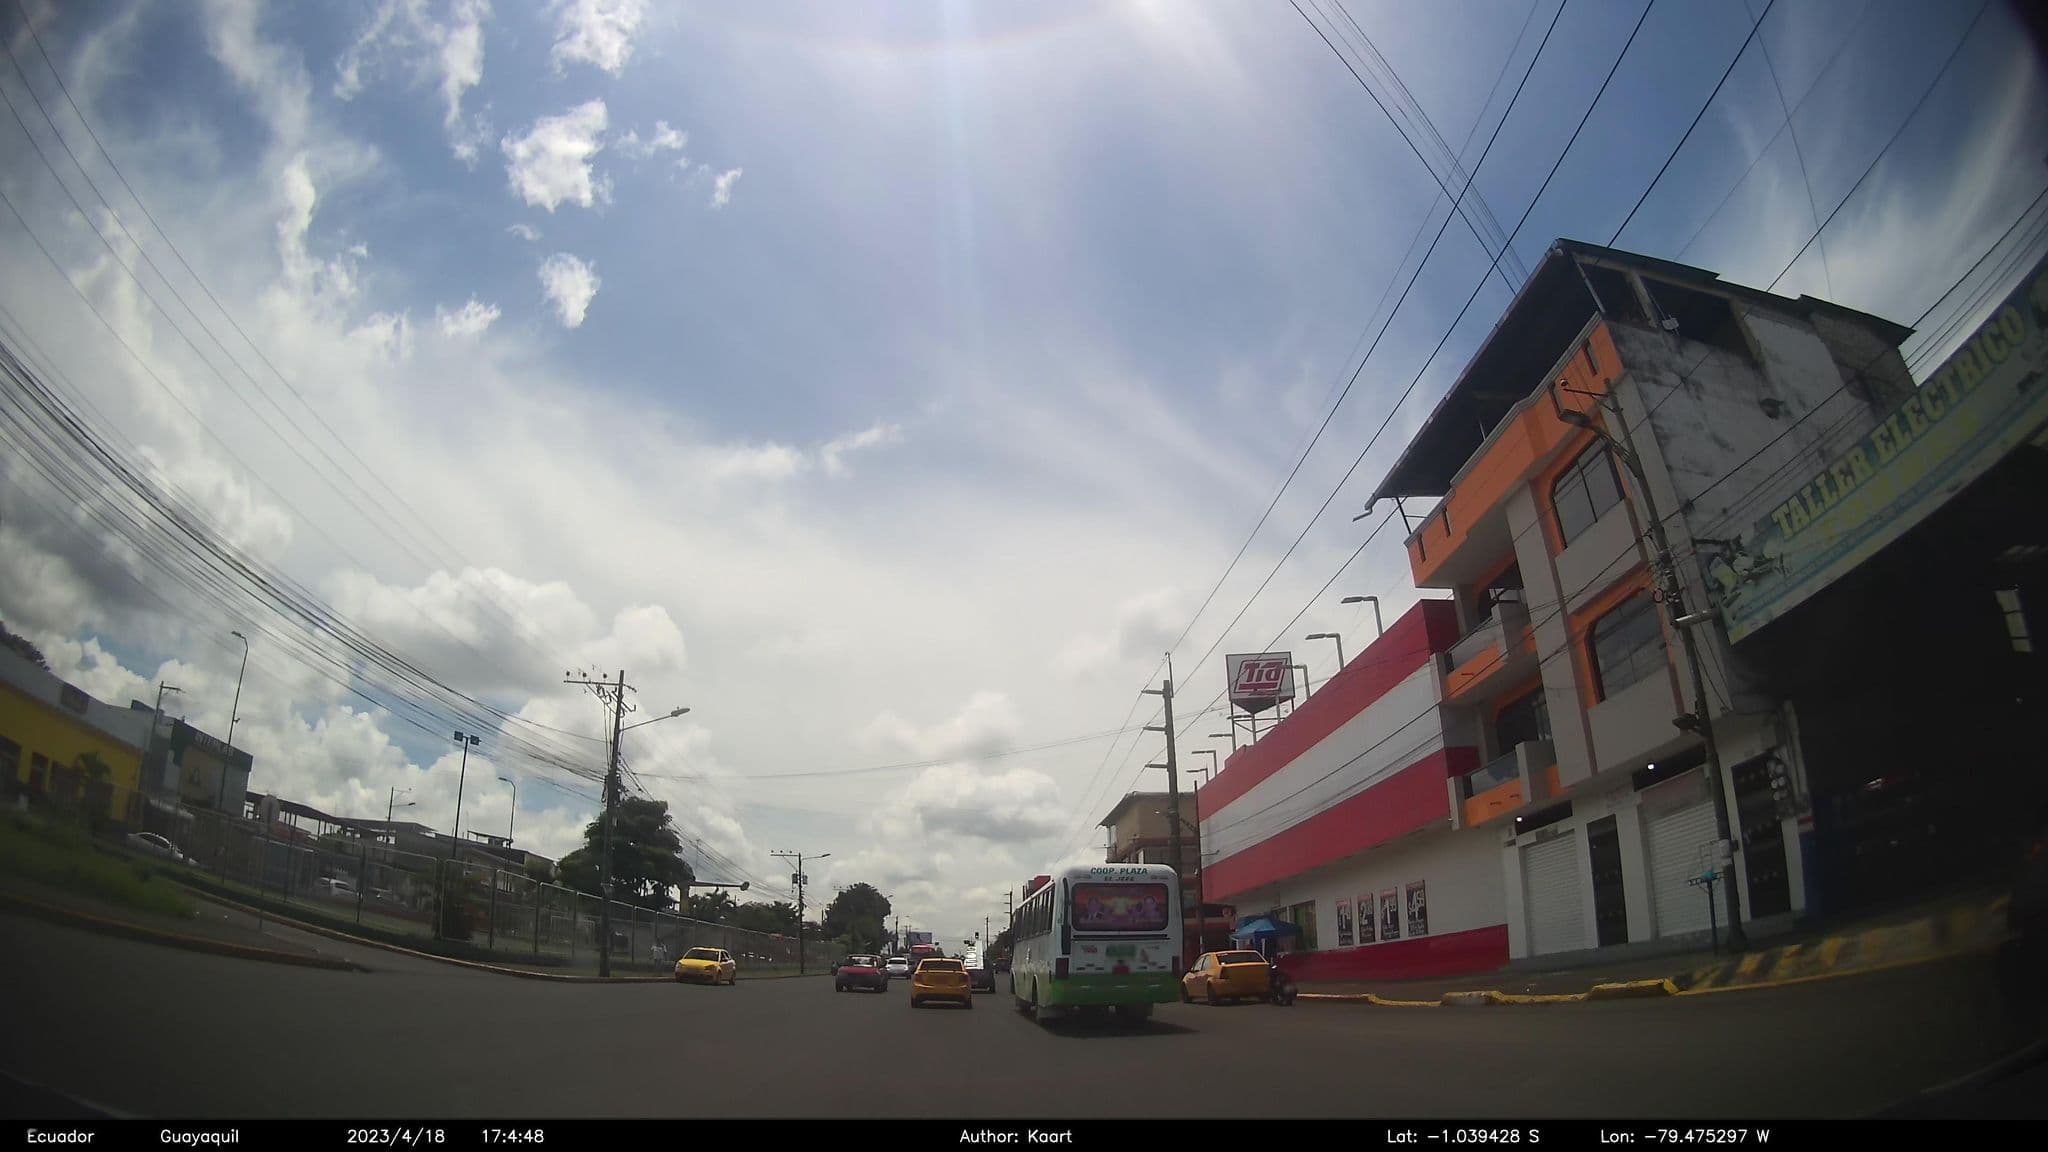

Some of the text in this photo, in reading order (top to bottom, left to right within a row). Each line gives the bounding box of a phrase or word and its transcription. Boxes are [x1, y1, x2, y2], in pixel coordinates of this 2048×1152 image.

[1772, 446, 1875, 541] TALLER
[1869, 304, 2028, 463] ELECTRICO
[1120, 867, 1148, 875] PLAZA
